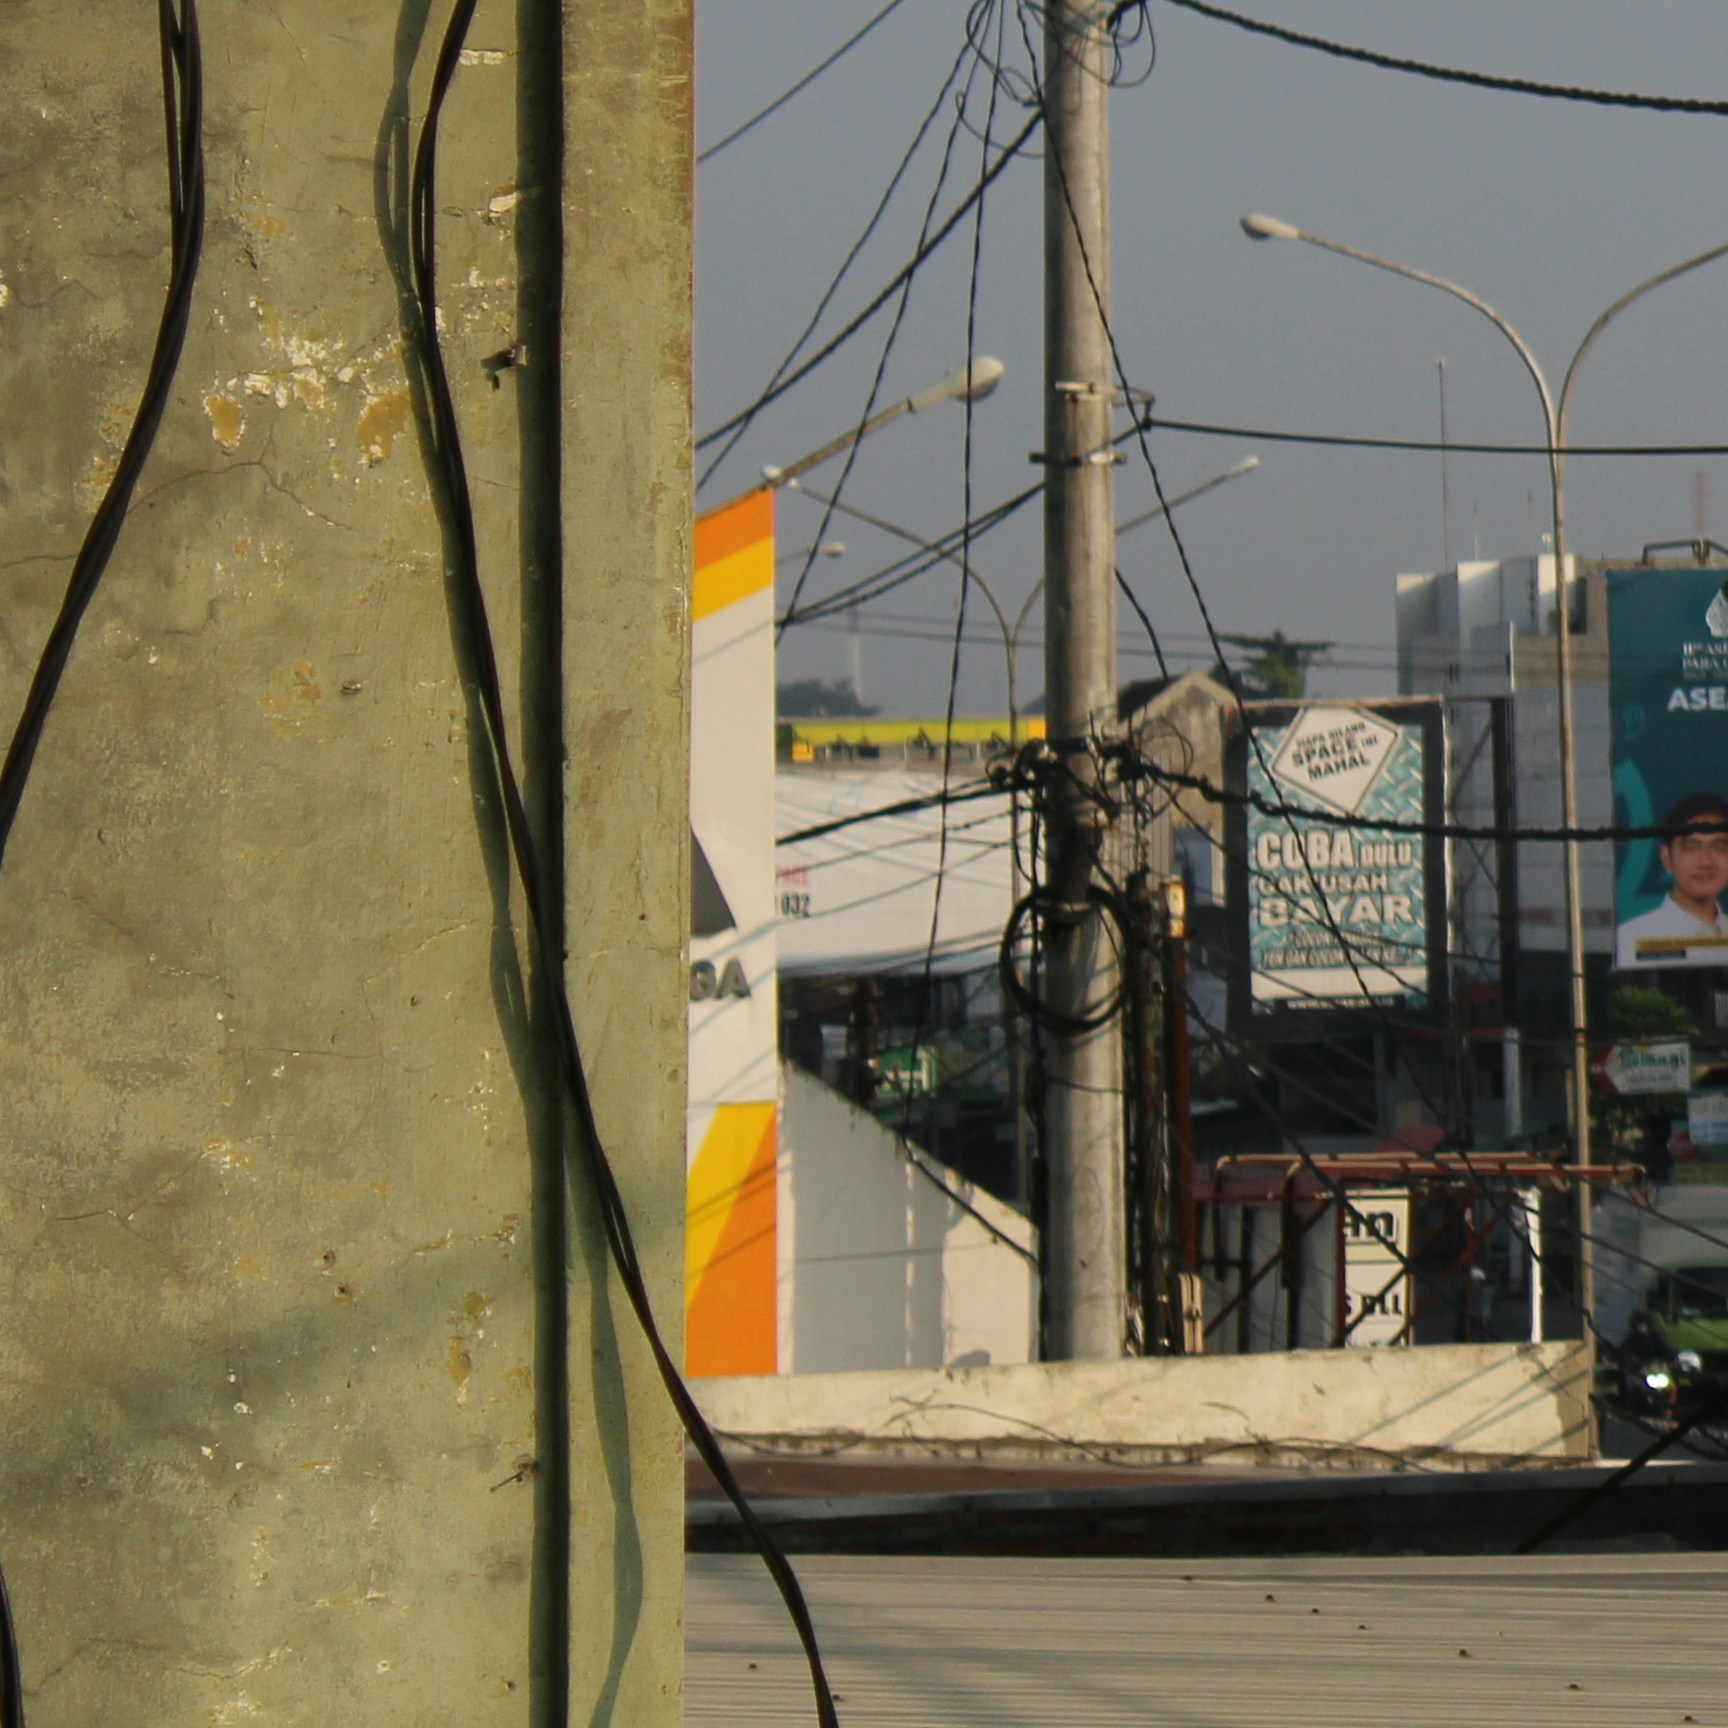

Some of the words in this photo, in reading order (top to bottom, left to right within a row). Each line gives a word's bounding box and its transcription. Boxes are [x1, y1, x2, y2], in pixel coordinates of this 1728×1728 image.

[1291, 736, 1358, 767] SPACE
[1307, 751, 1370, 782] MAHAL
[1256, 830, 1355, 870] COBA
[1358, 842, 1413, 867] DULU
[1257, 874, 1311, 895] GAK
[1318, 873, 1388, 893] USAH
[1258, 895, 1414, 925] BAYAR
